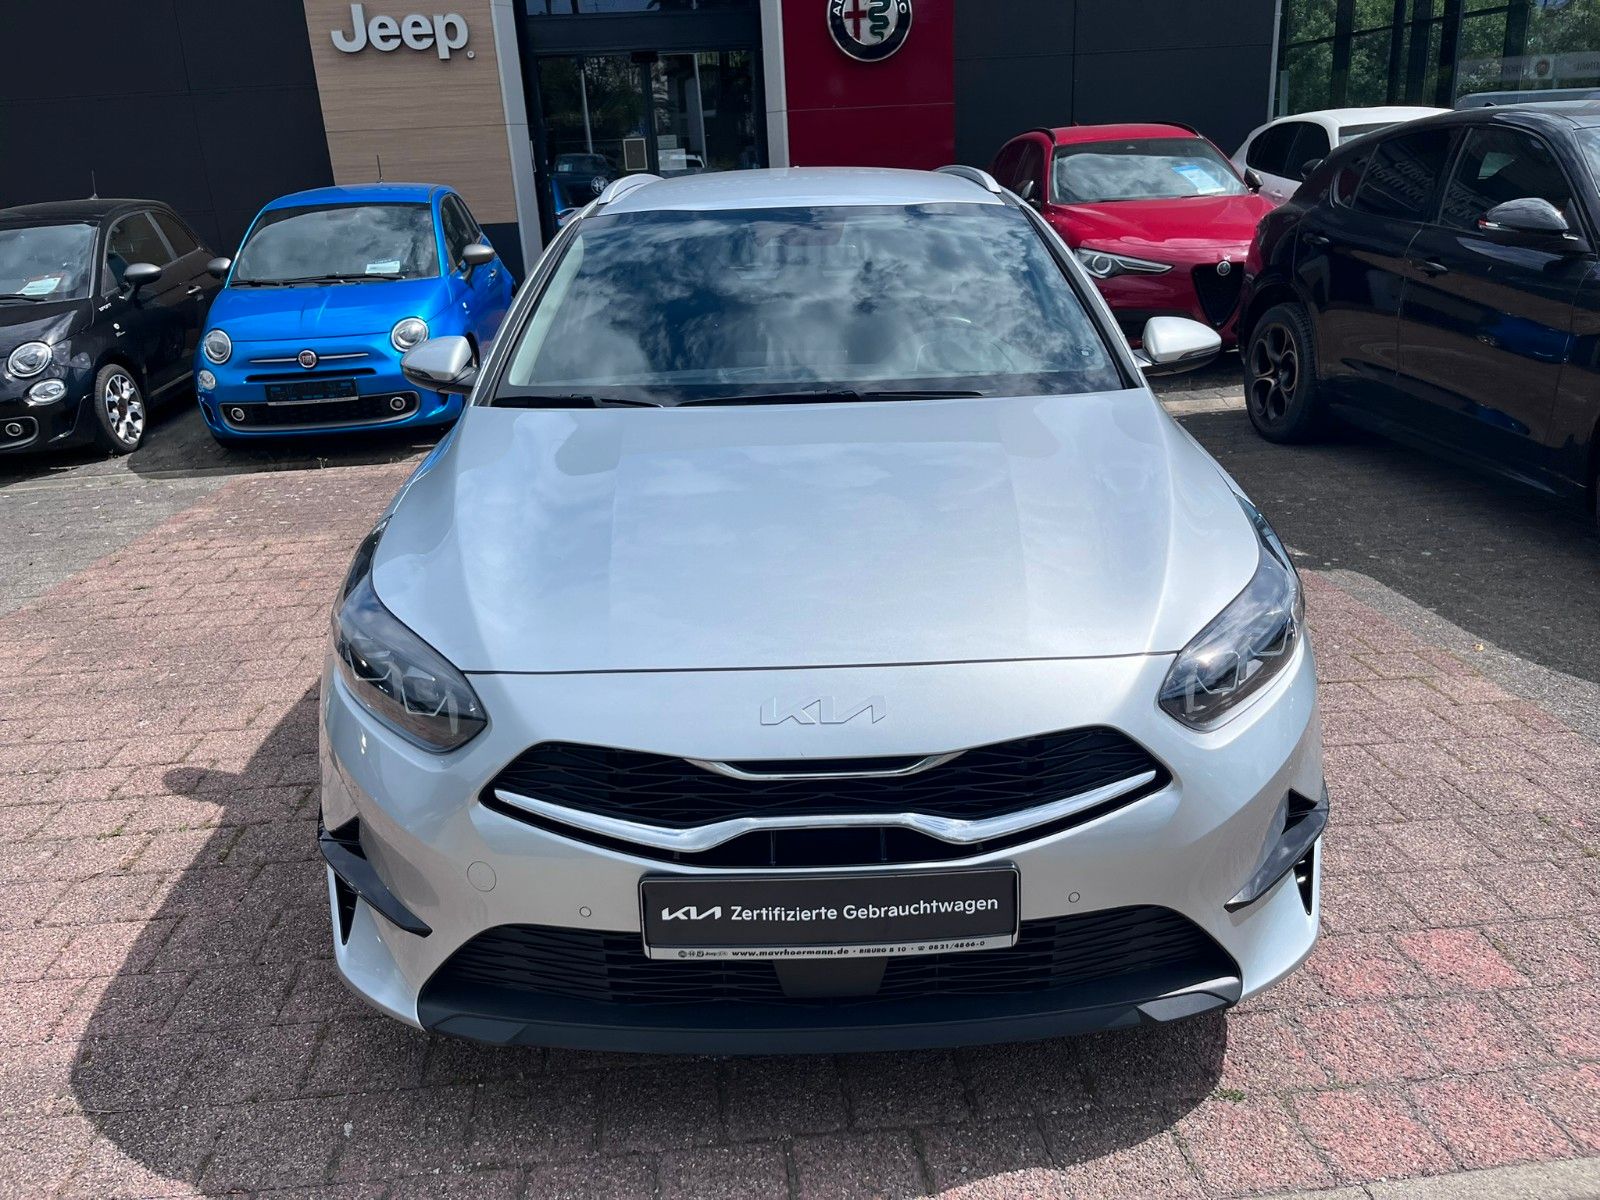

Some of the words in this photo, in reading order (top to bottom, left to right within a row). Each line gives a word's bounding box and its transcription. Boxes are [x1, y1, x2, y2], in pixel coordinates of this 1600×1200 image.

[331, 4, 469, 60] Jeep
[760, 696, 887, 725] KIA
[661, 906, 722, 920] KIA
[730, 906, 838, 921] Zertifizierte
[842, 898, 999, 920] Gebrauchtwagen
